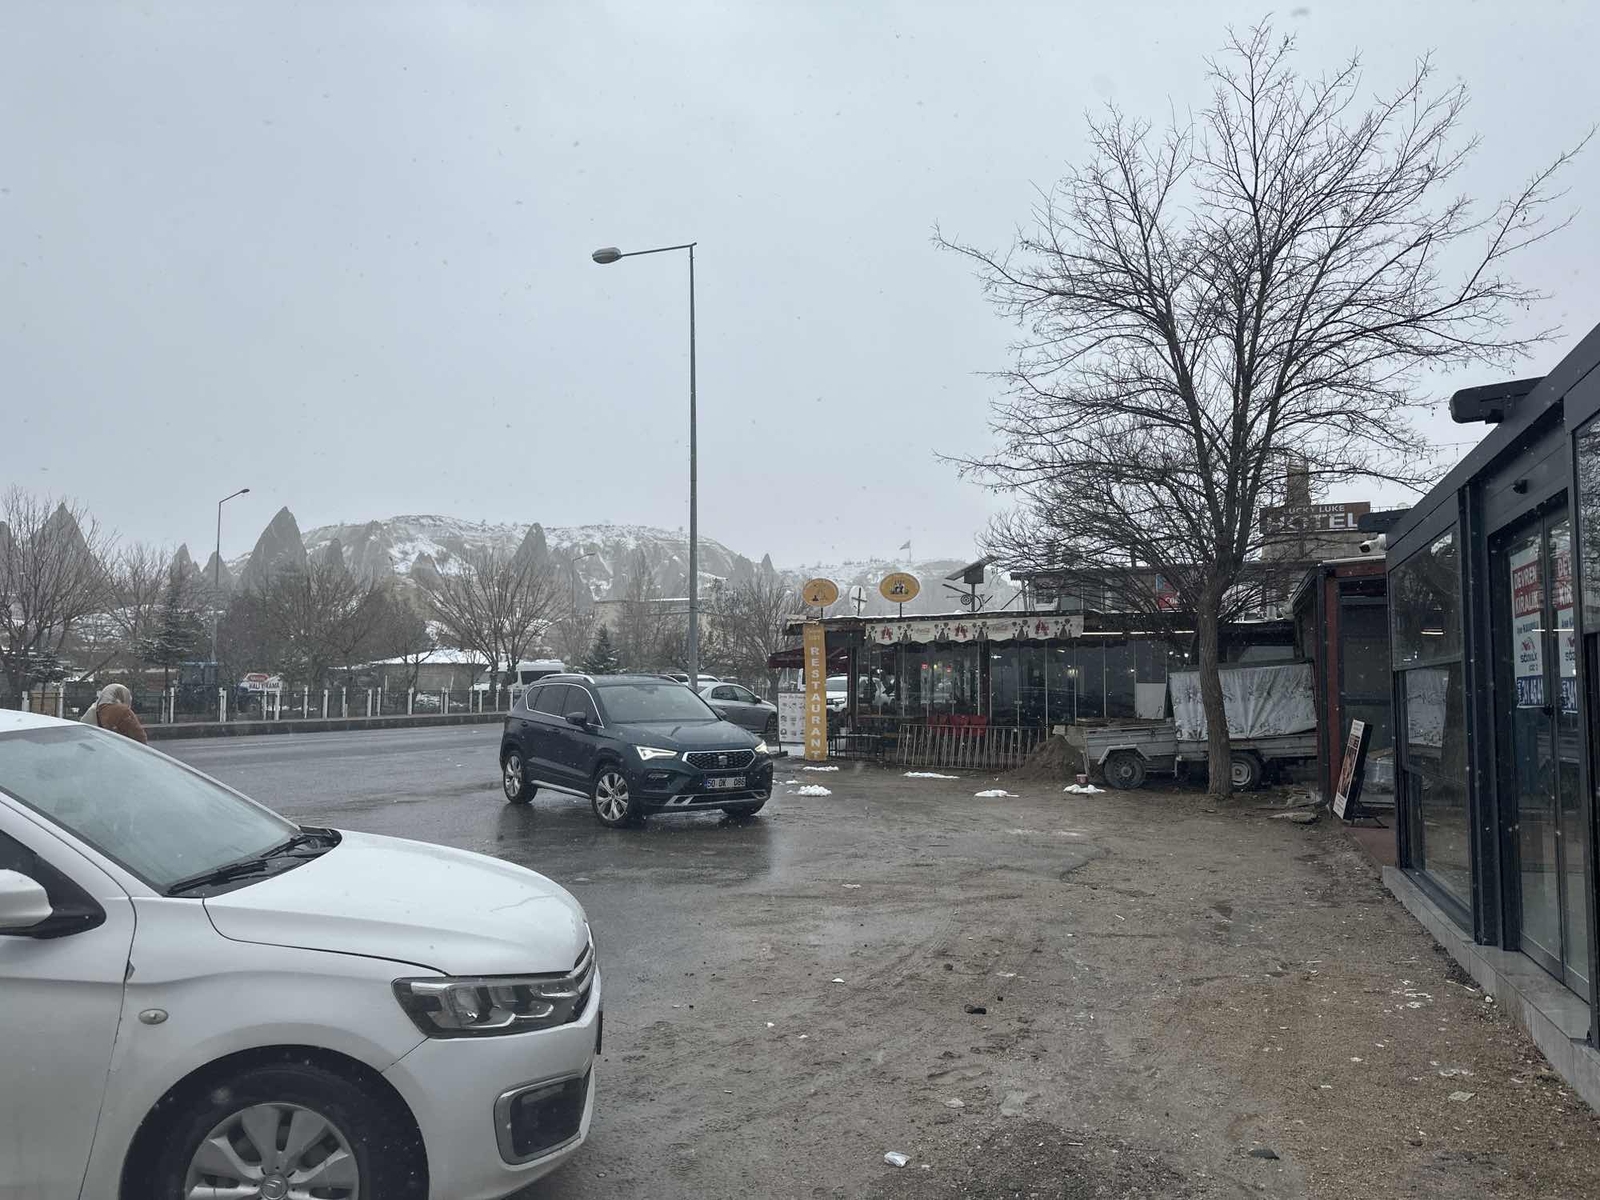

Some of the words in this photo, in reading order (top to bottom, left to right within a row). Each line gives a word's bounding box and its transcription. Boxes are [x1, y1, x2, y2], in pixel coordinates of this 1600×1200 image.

[1319, 505, 1345, 513] LUKE
[1514, 564, 1537, 590] DEVREN
[809, 646, 821, 759] RESTAURANT
